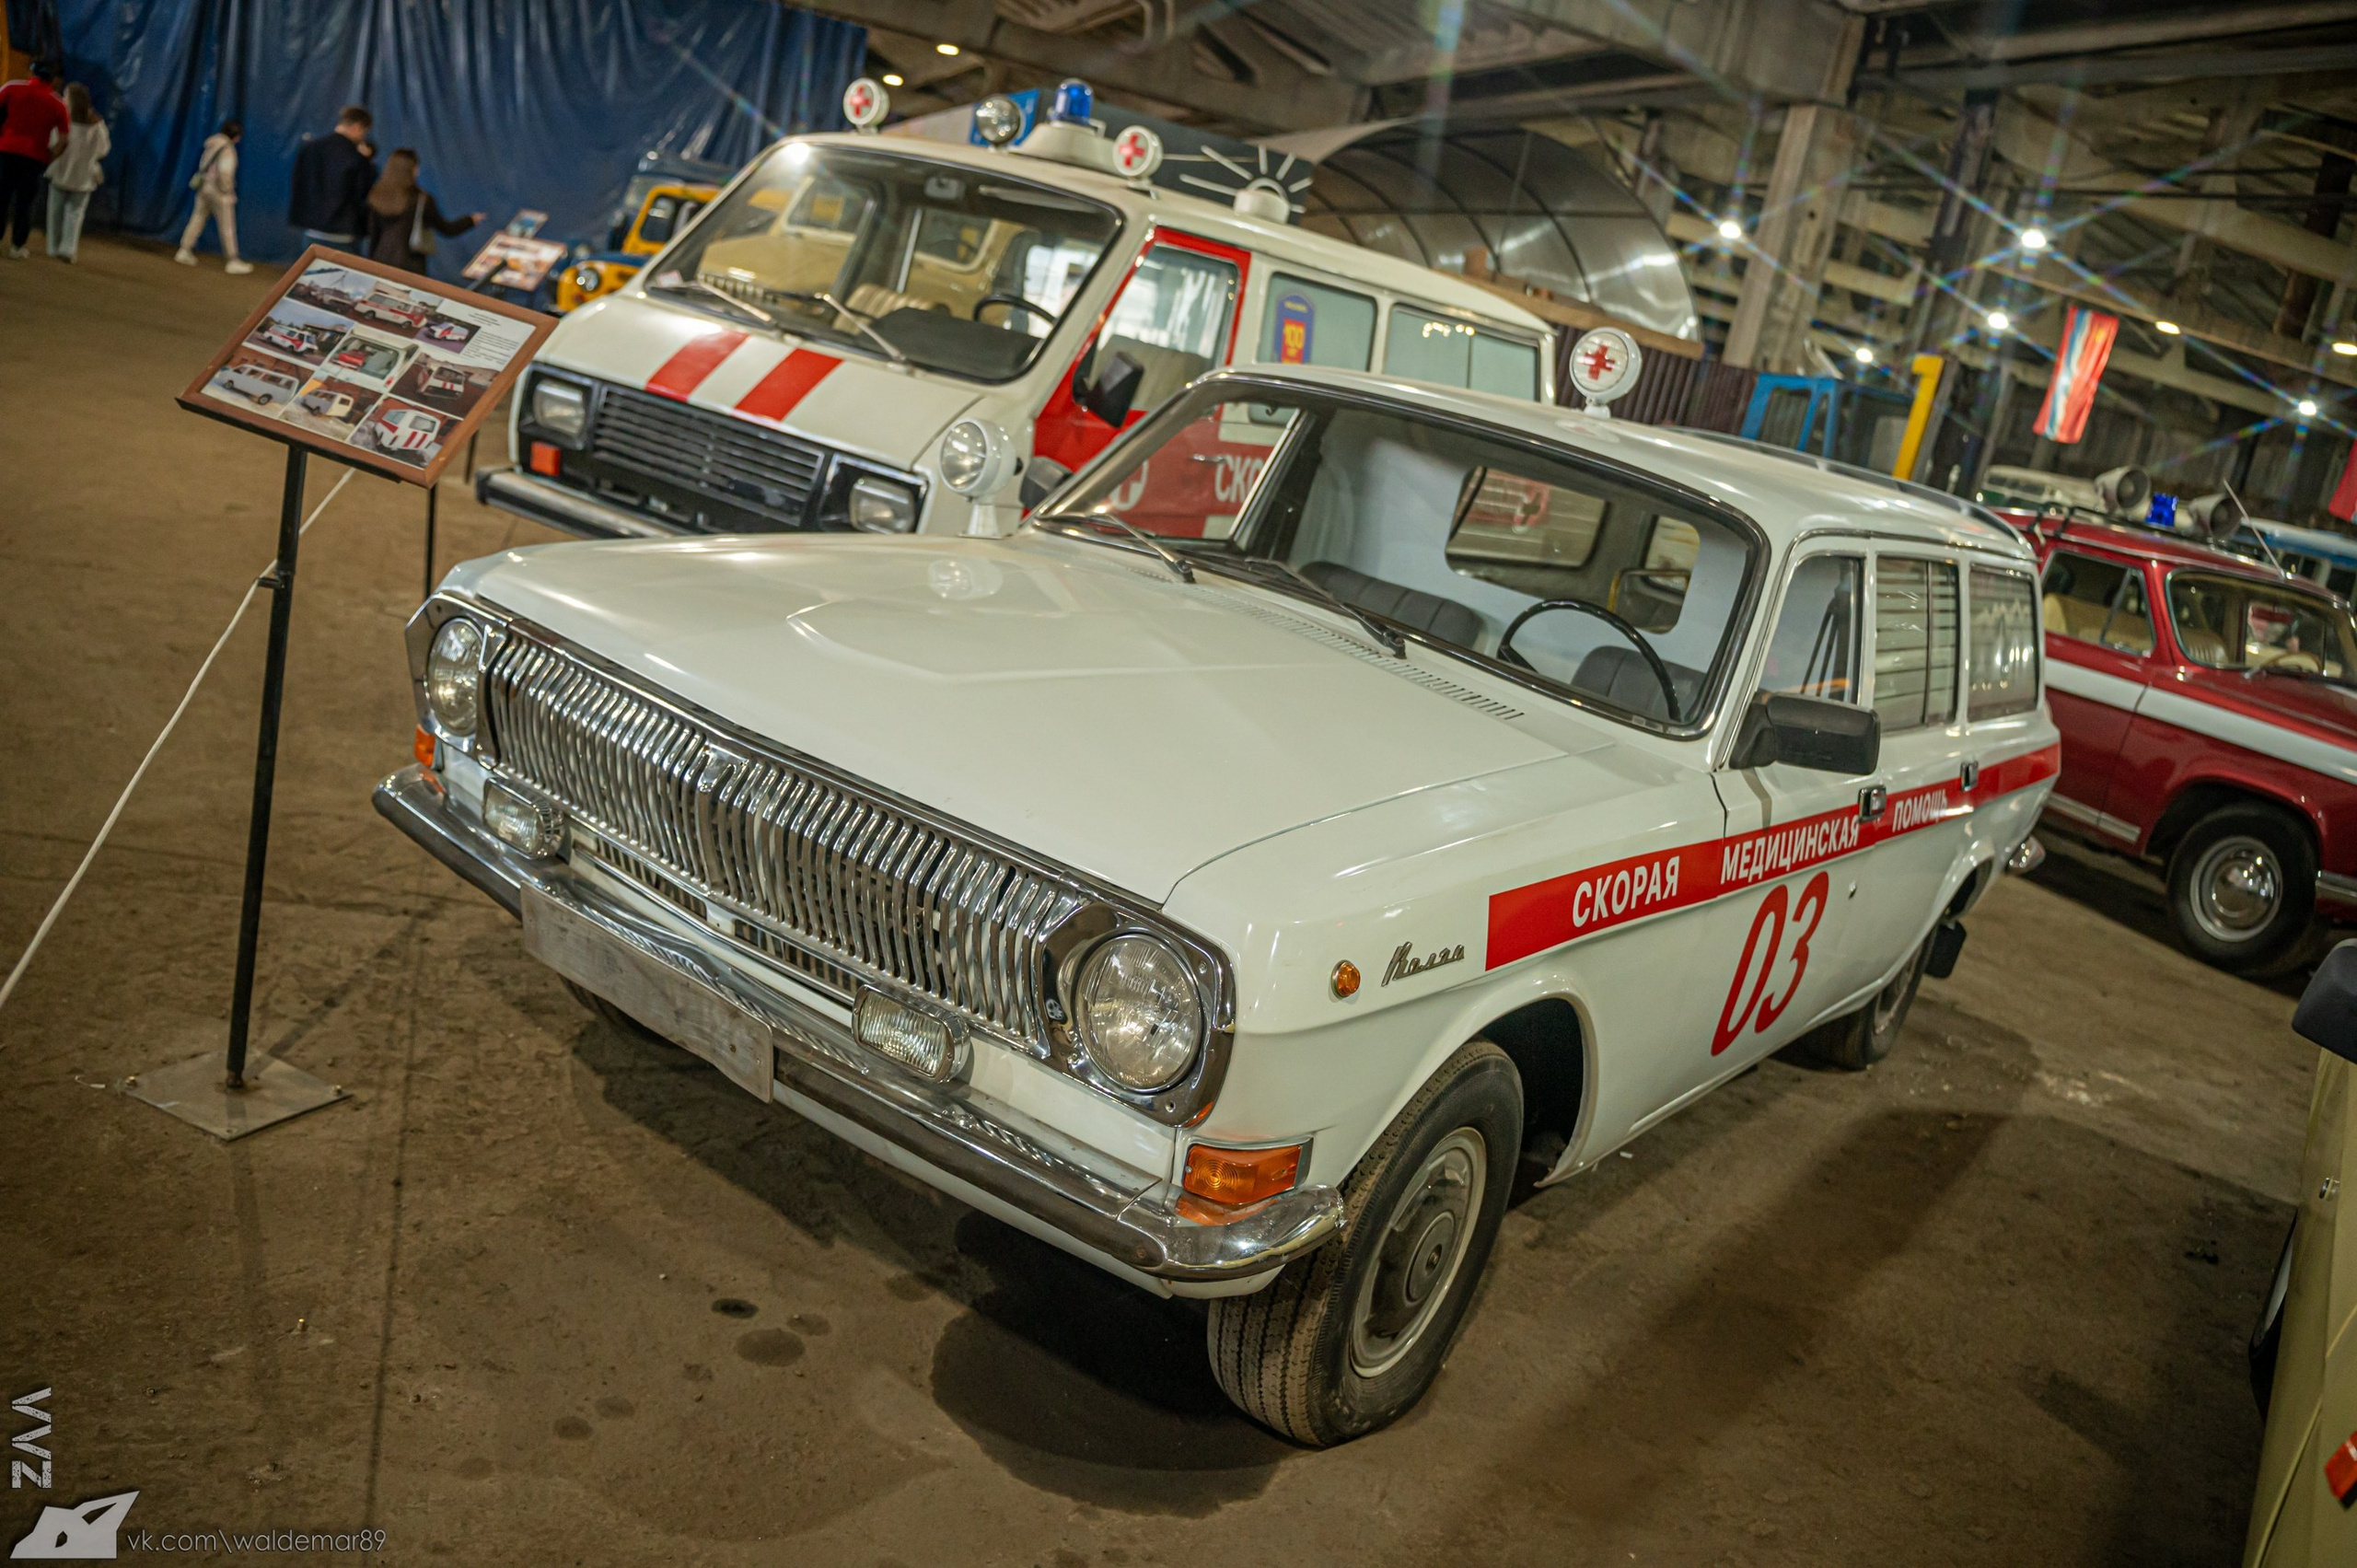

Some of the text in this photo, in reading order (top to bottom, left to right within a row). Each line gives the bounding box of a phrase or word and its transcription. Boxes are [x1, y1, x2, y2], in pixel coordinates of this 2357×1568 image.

[1572, 788, 1948, 928] СКОРАЯ МЕДИЦИНСКАЯ ПОМОЩЬ
[1711, 870, 1829, 1057] 03
